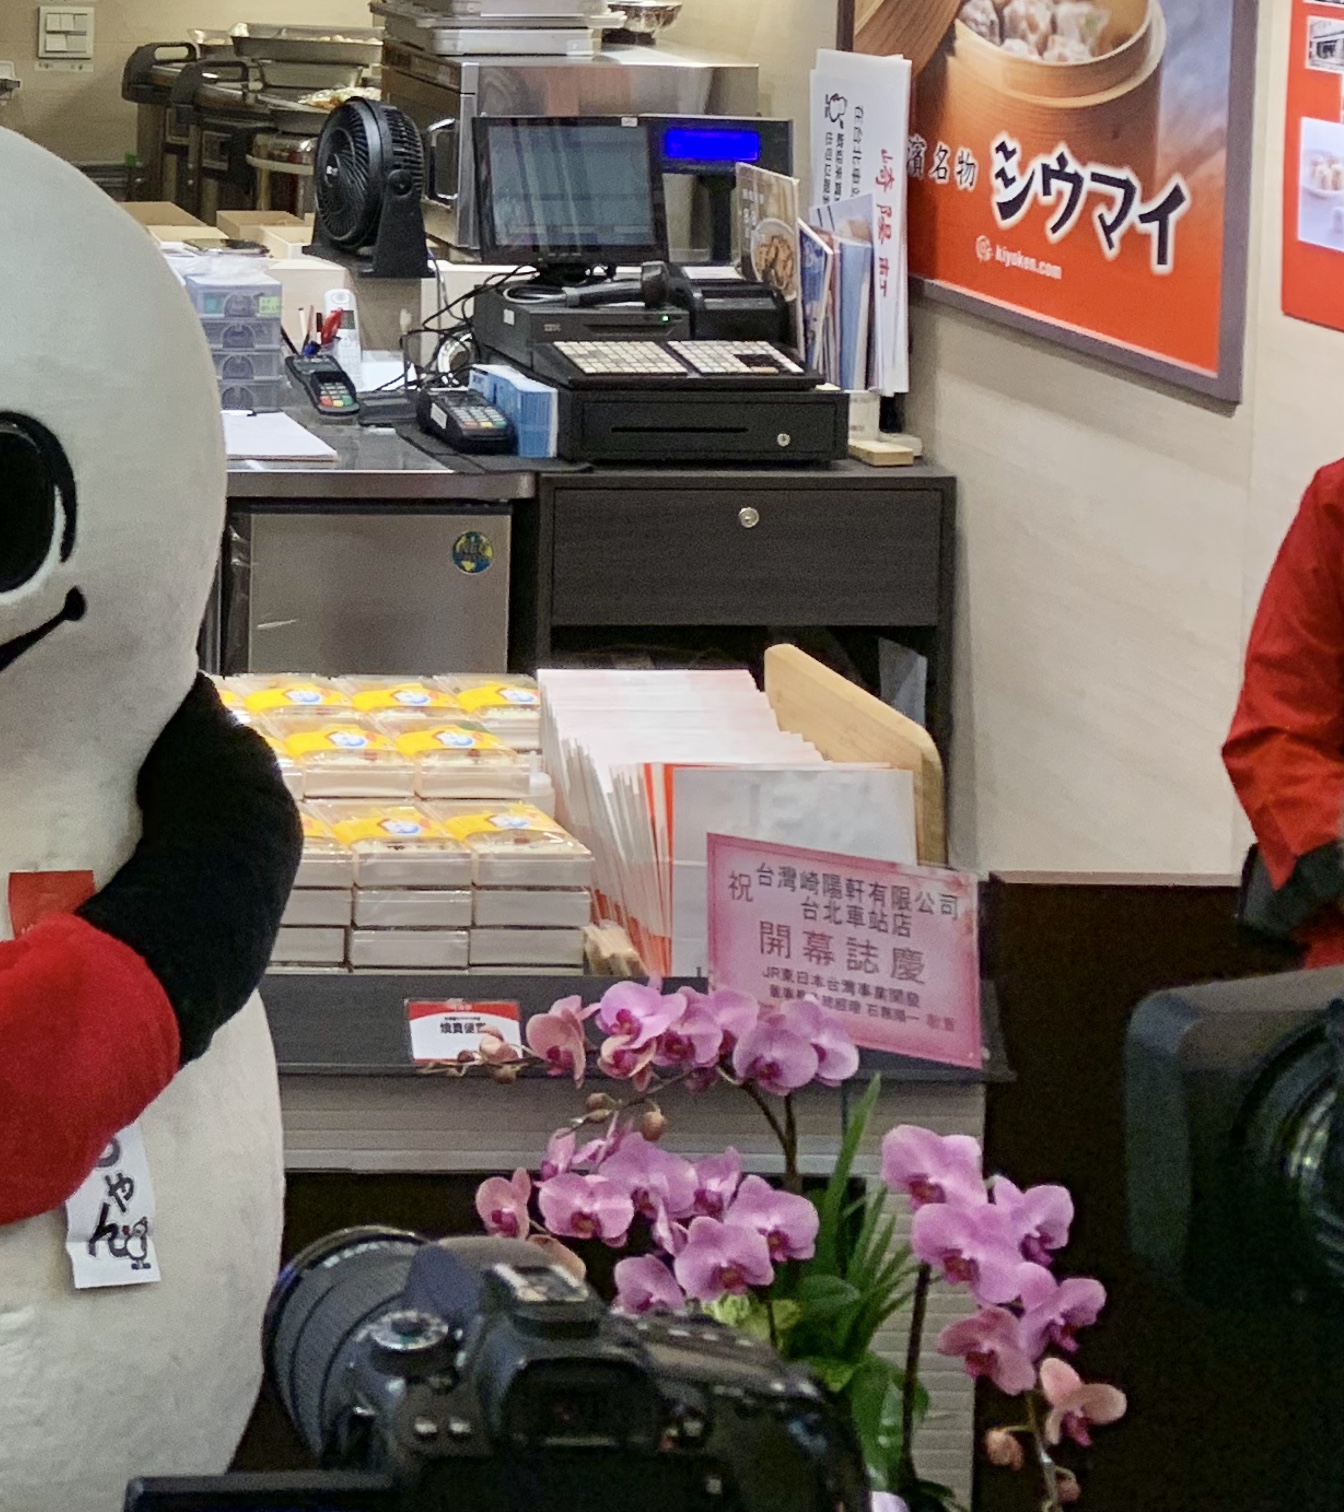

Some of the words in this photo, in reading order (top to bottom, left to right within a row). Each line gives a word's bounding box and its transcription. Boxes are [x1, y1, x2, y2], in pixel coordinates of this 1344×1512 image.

[994, 140, 1187, 266] シウマイ
[994, 243, 1062, 281] kiyoken.com
[727, 871, 754, 903] 祝
[756, 862, 959, 921] 台灣崎陽軒有限公司
[801, 896, 913, 938] 台北車站店
[759, 921, 926, 985] 開幕誌慶
